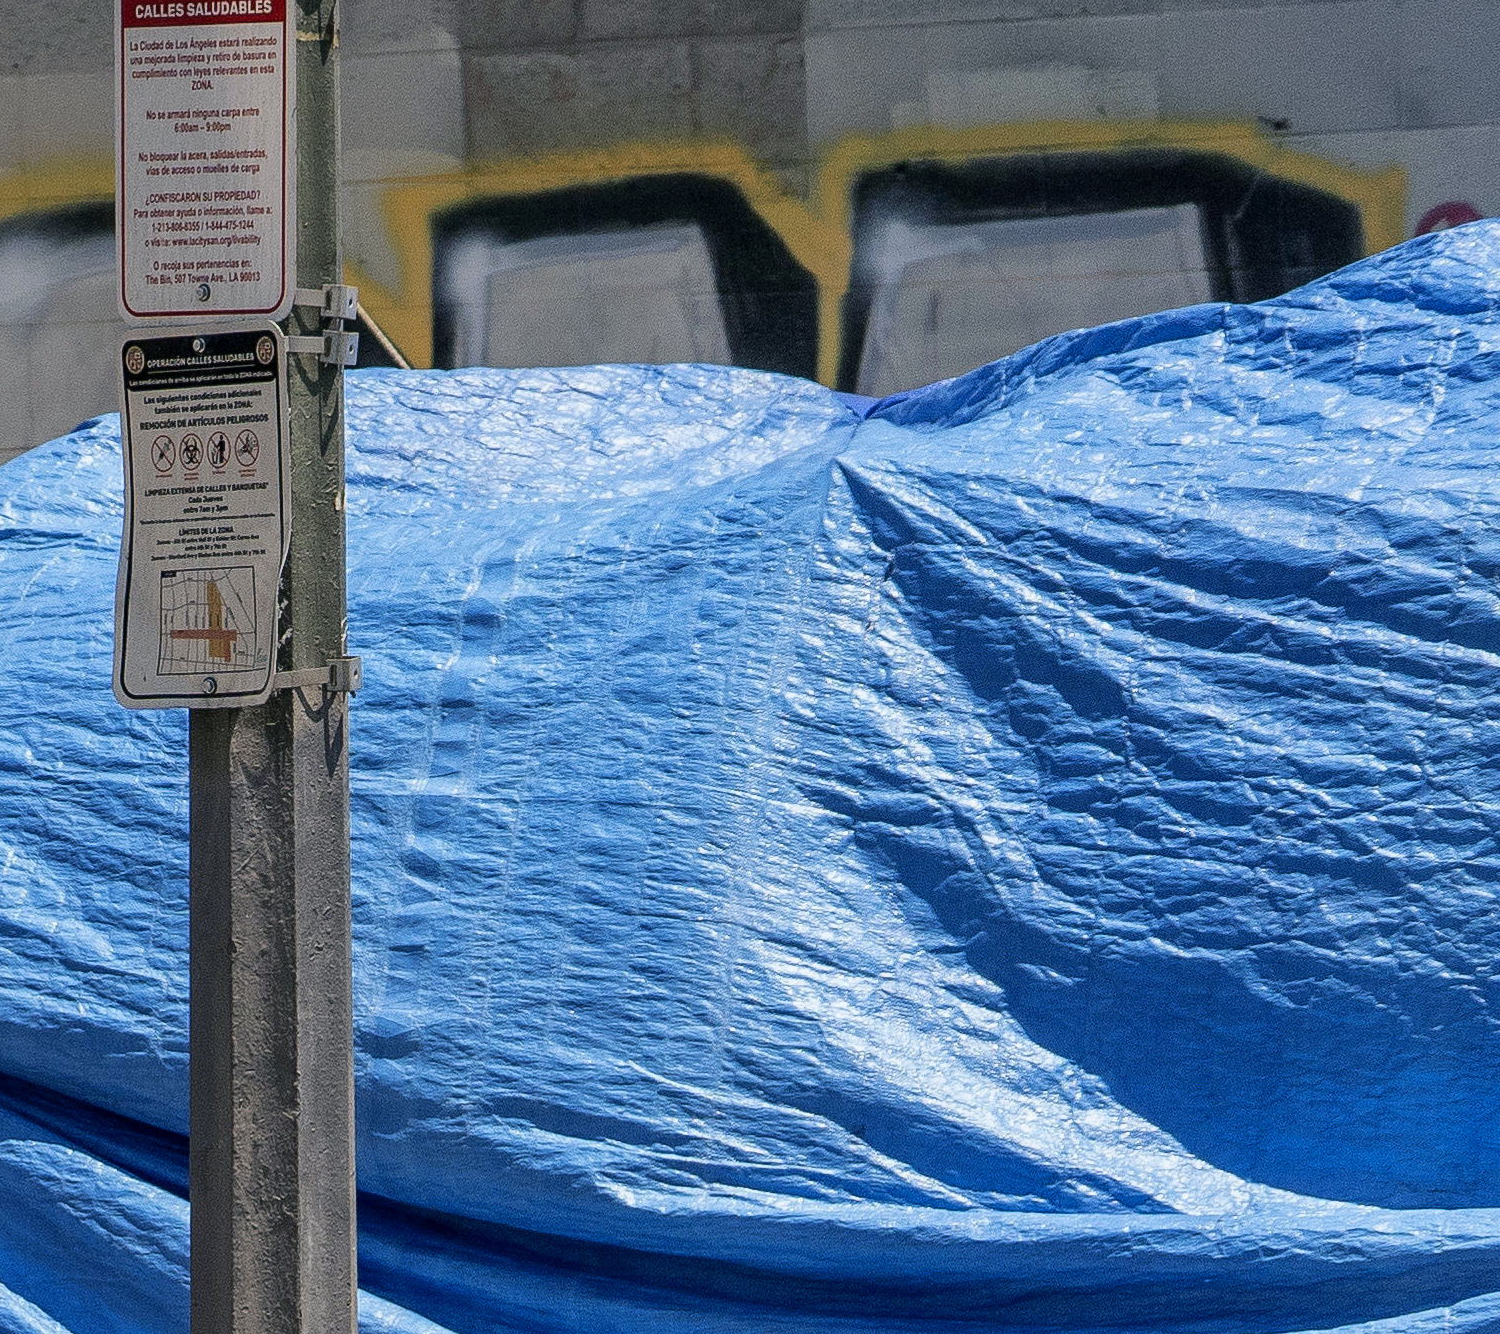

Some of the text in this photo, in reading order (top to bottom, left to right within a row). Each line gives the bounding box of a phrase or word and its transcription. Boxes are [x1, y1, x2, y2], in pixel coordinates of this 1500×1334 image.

[135, 0, 273, 19] CALLES SALUDABLES
[130, 36, 277, 51] La Ciudad de Los Ángeles estará realizando
[144, 53, 176, 66] mejorada
[178, 53, 204, 65] limpieza
[206, 55, 211, 63] y
[213, 52, 230, 61] retiro
[232, 52, 241, 61] de
[243, 51, 266, 61] basura
[268, 52, 277, 60] en
[132, 65, 275, 80] cumplimiento con leyes relevantes en esta
[191, 80, 214, 91] ZONA.
[146, 108, 260, 121] No se armará ninguna carpa entre
[174, 123, 199, 133] 6:00am
[206, 122, 231, 133] 9:00pm
[138, 152, 148, 162] No
[149, 150, 179, 163] bloquear
[180, 151, 187, 161] la
[161, 165, 171, 174] de
[172, 166, 195, 174] acceso
[231, 163, 239, 173] de
[241, 164, 260, 175] carga
[145, 190, 261, 206] ¿CONFISCARON SU PROPIEDAD?
[133, 208, 148, 218] Para
[150, 207, 175, 218] obtener
[176, 207, 196, 219] ayuda
[196, 259, 239, 271] pertenencias
[145, 274, 158, 285] The
[229, 272, 239, 282] LA
[147, 352, 255, 368] OPERACIÓN CALLES SALUDABLES
[140, 413, 269, 430] REMOCIÓN DE ARTÍCULOS PELIGROSOS
